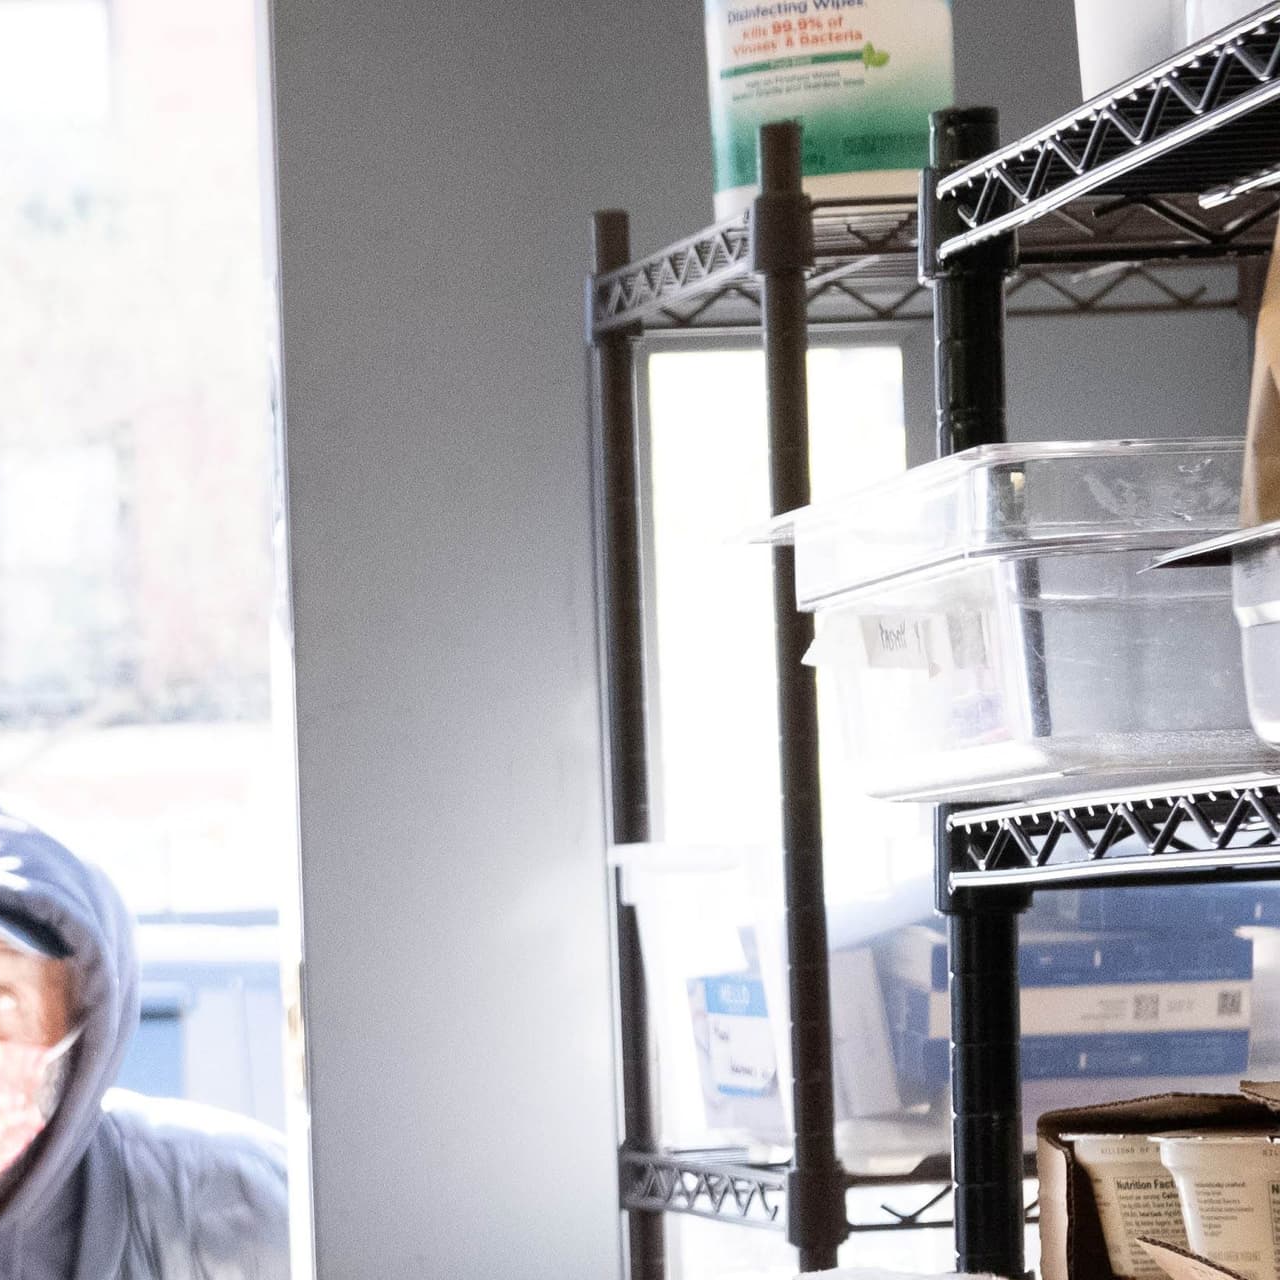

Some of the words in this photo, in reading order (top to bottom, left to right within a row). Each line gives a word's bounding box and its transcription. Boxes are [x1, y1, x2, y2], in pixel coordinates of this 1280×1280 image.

[728, 1, 808, 25] Disinfecting
[772, 18, 824, 36] 99.9%
[828, 15, 845, 29] of
[800, 29, 864, 46] Bacteria
[1116, 1179, 1152, 1190] Nutrition
